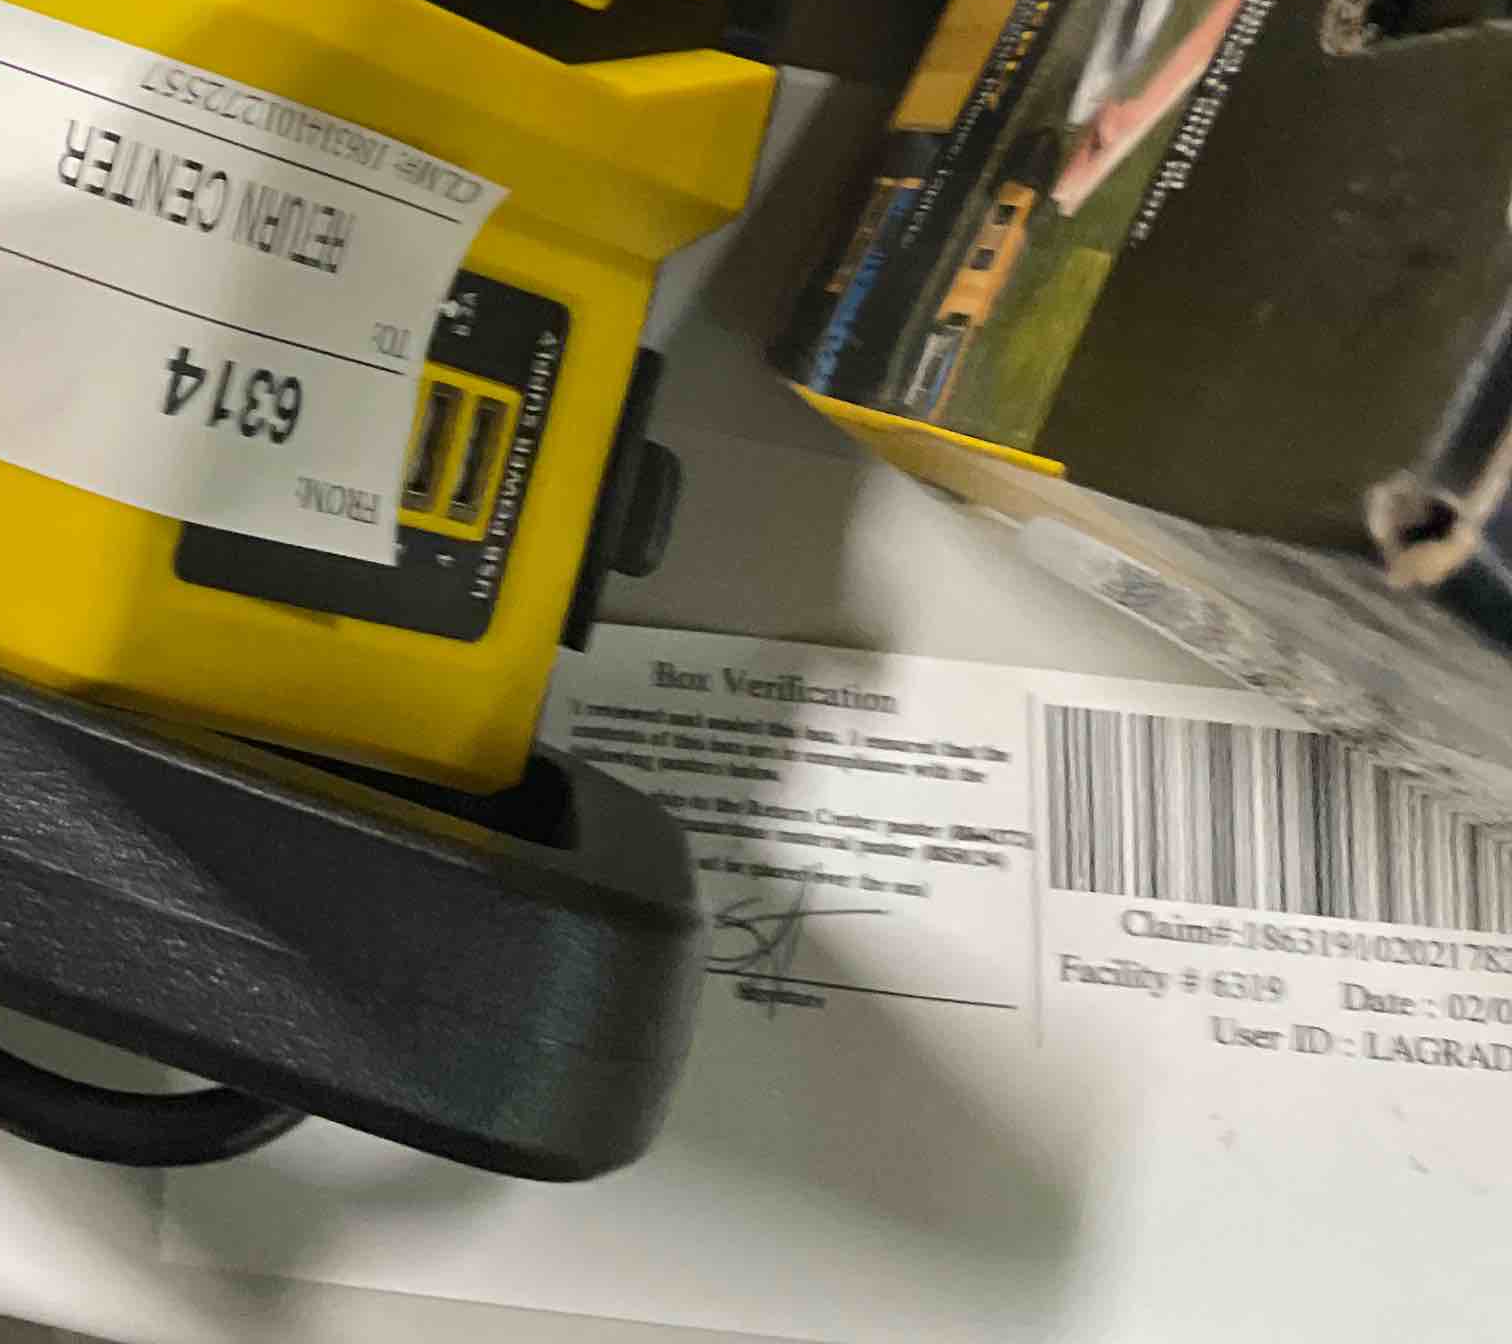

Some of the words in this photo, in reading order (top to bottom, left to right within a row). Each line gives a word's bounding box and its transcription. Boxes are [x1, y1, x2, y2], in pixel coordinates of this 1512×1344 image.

[47, 117, 235, 235] CENTER
[151, 340, 310, 450] 6314
[722, 666, 899, 714] Verification
[1209, 1015, 1287, 1051] User
